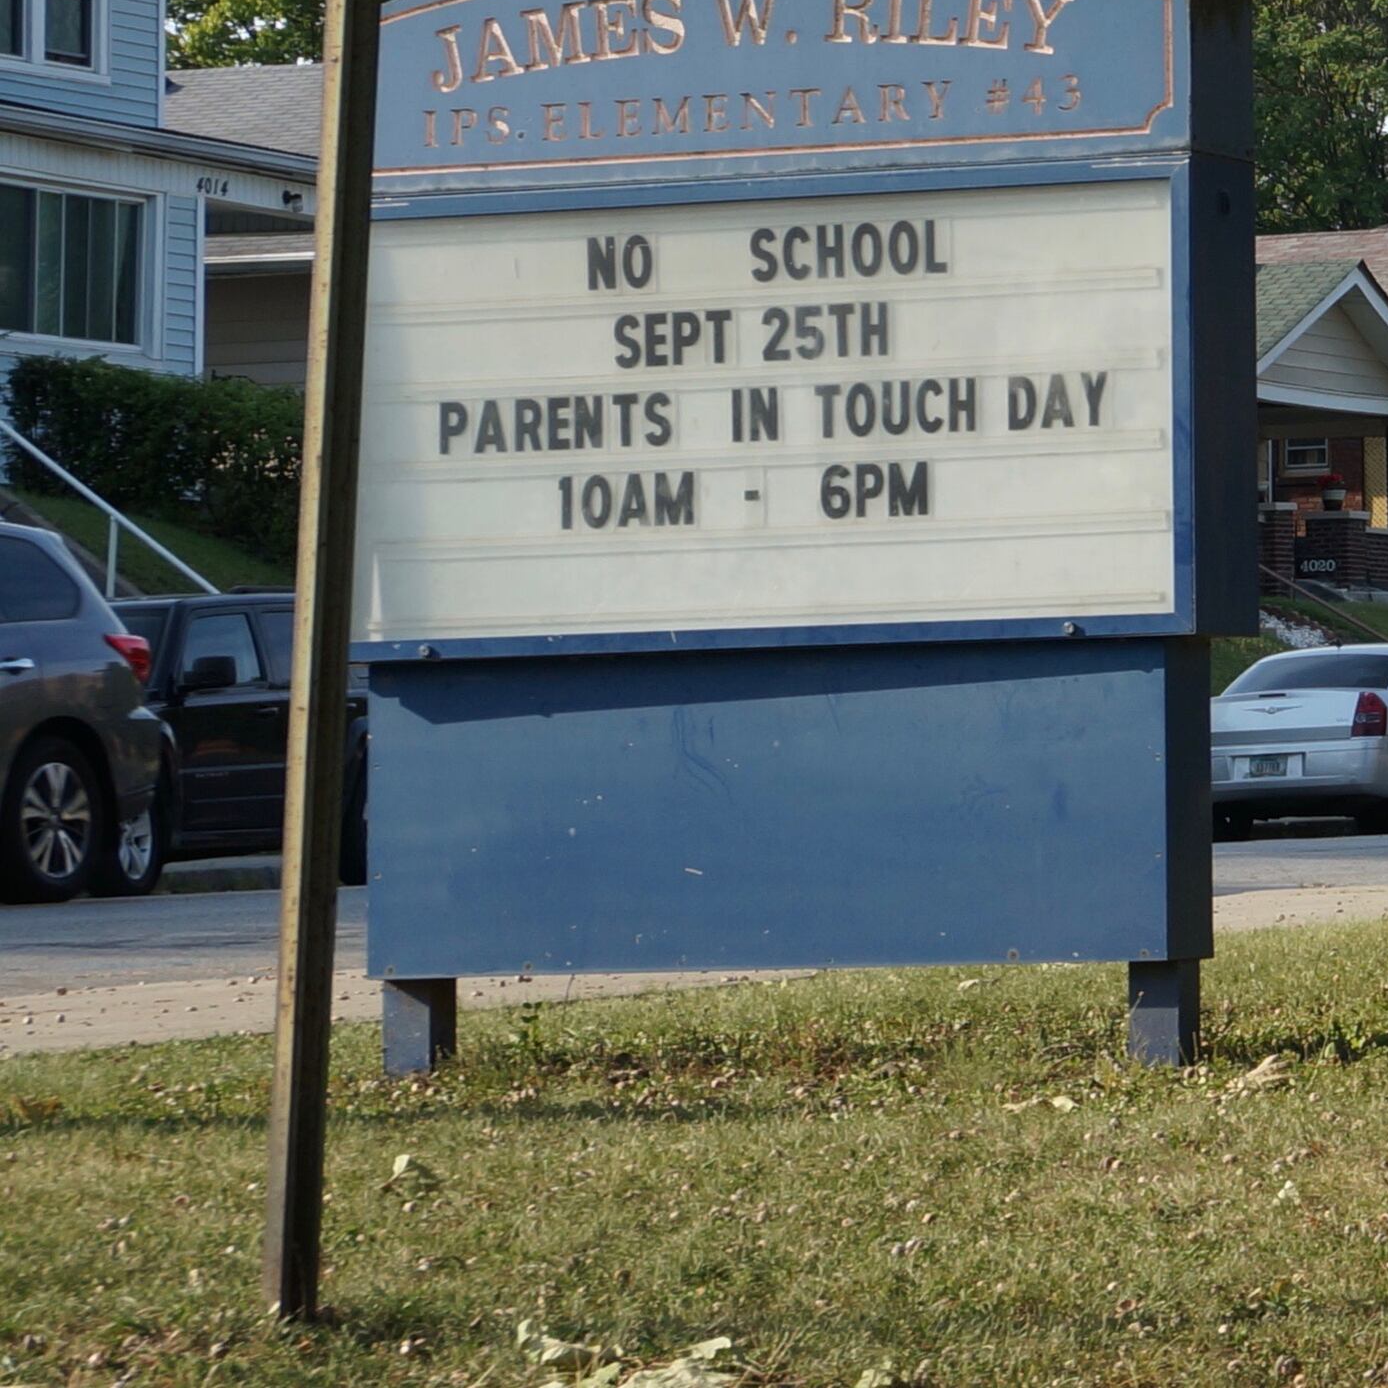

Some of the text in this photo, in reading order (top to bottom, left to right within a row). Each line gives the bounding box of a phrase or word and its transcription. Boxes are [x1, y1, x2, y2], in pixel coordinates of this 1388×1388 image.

[540, 78, 953, 142] ELEMENTARY
[985, 73, 1082, 116] #43
[196, 176, 229, 197] 4014
[587, 219, 948, 290] NO SCHOOL
[614, 301, 889, 369] SEPT 25TH
[439, 372, 1108, 455] PARENTS IN TOUCH DAY
[558, 470, 695, 530] 10AM
[820, 460, 929, 519] 6PM
[1300, 559, 1336, 572] 4020
